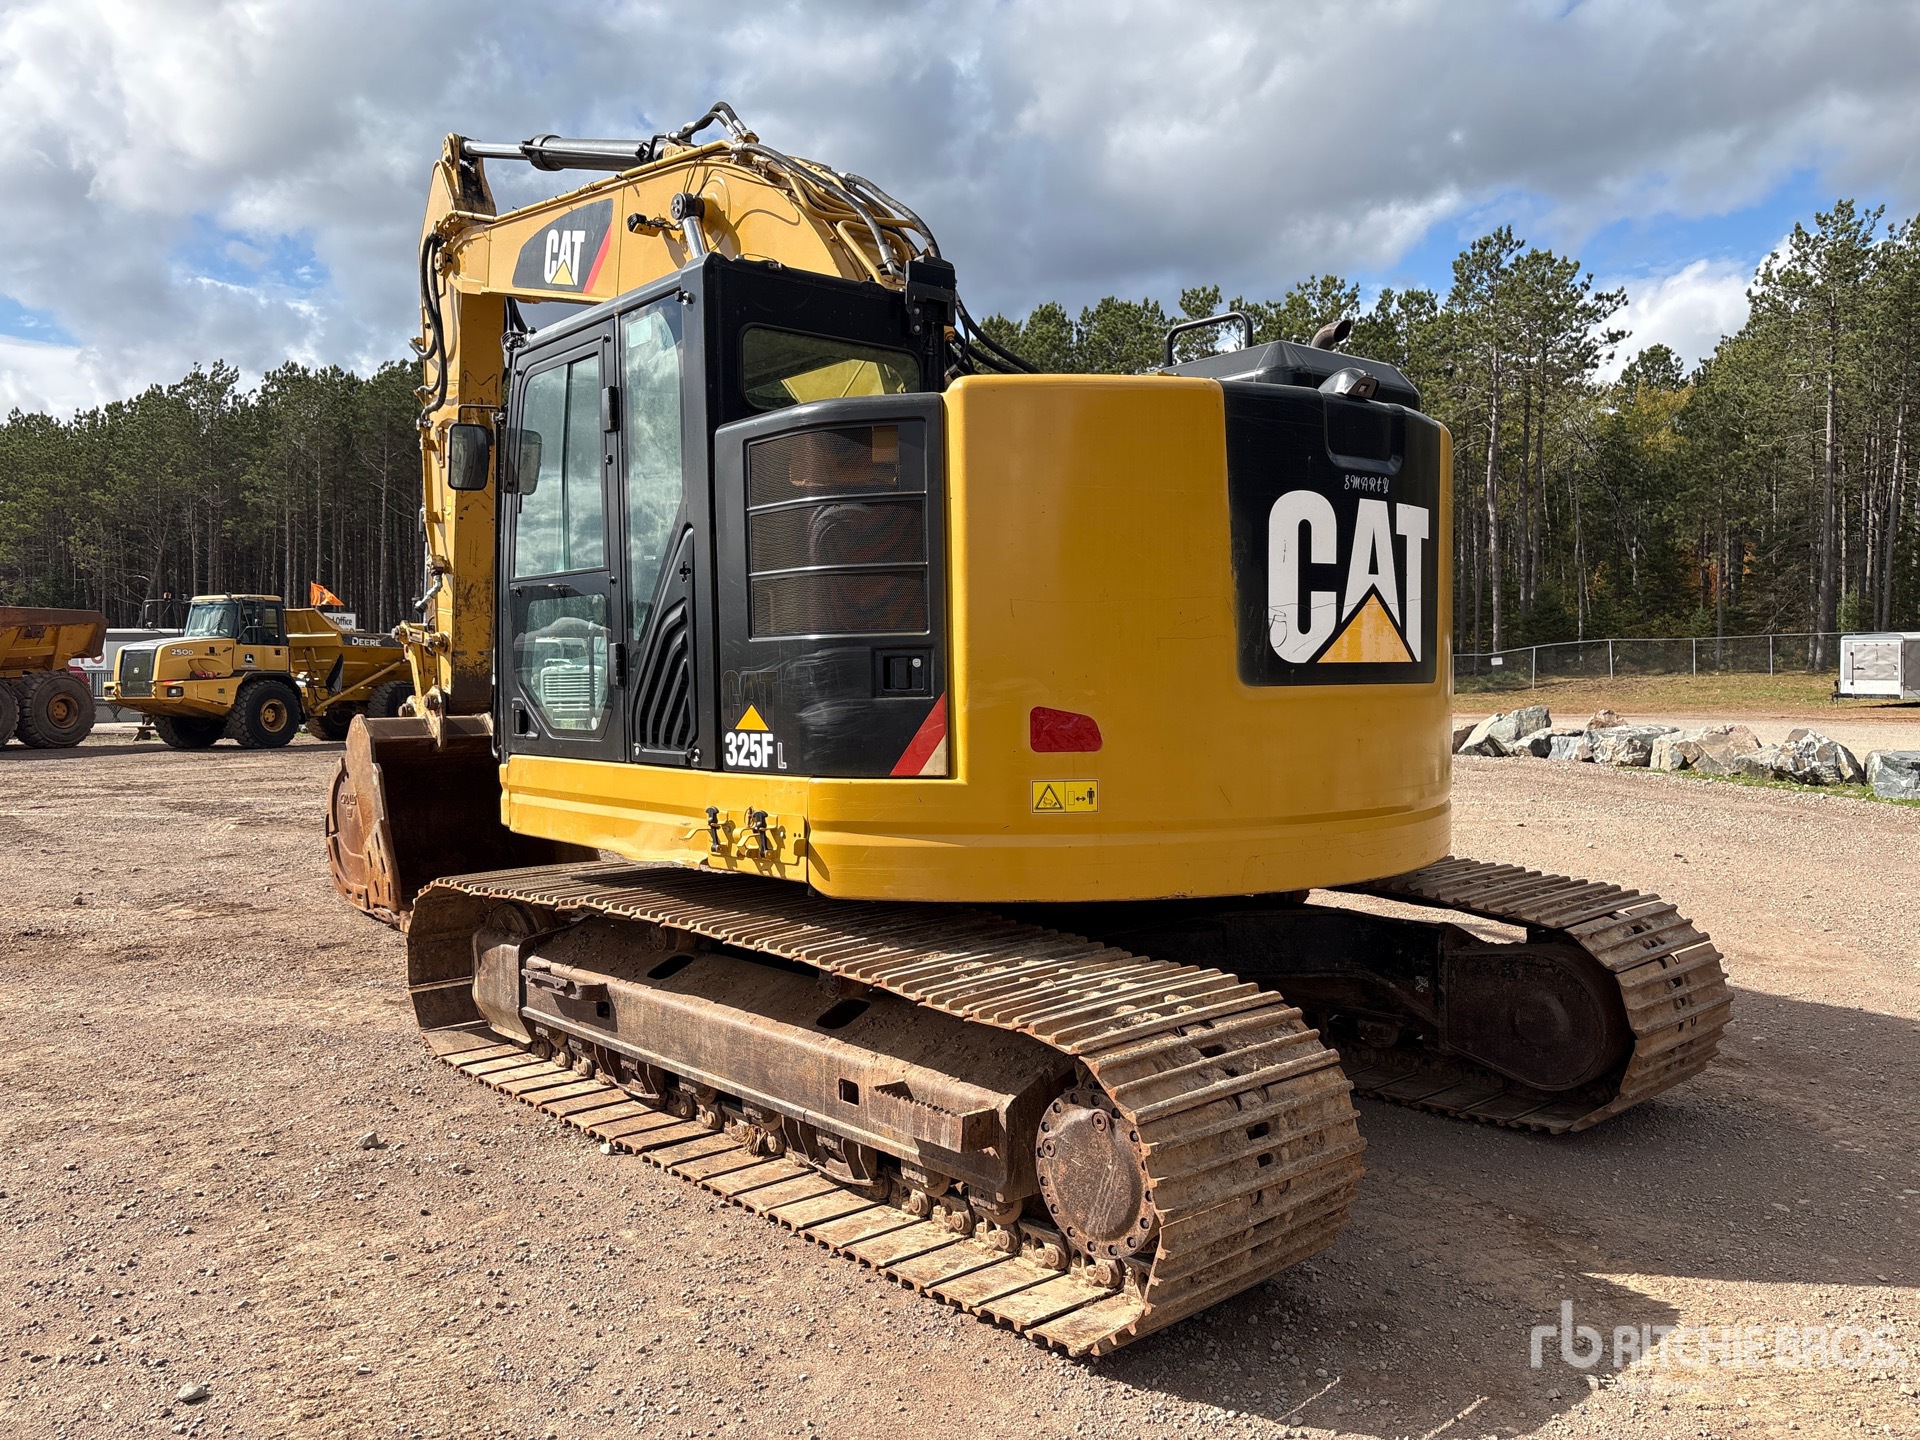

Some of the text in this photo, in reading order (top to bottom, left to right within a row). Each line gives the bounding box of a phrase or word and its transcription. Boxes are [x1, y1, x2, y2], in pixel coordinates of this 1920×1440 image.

[544, 229, 586, 286] CAT
[1268, 490, 1430, 664] CAT
[335, 616, 353, 626] Office
[170, 648, 194, 656] 250D
[351, 636, 382, 647] DEERE
[725, 731, 788, 769] 325F L
